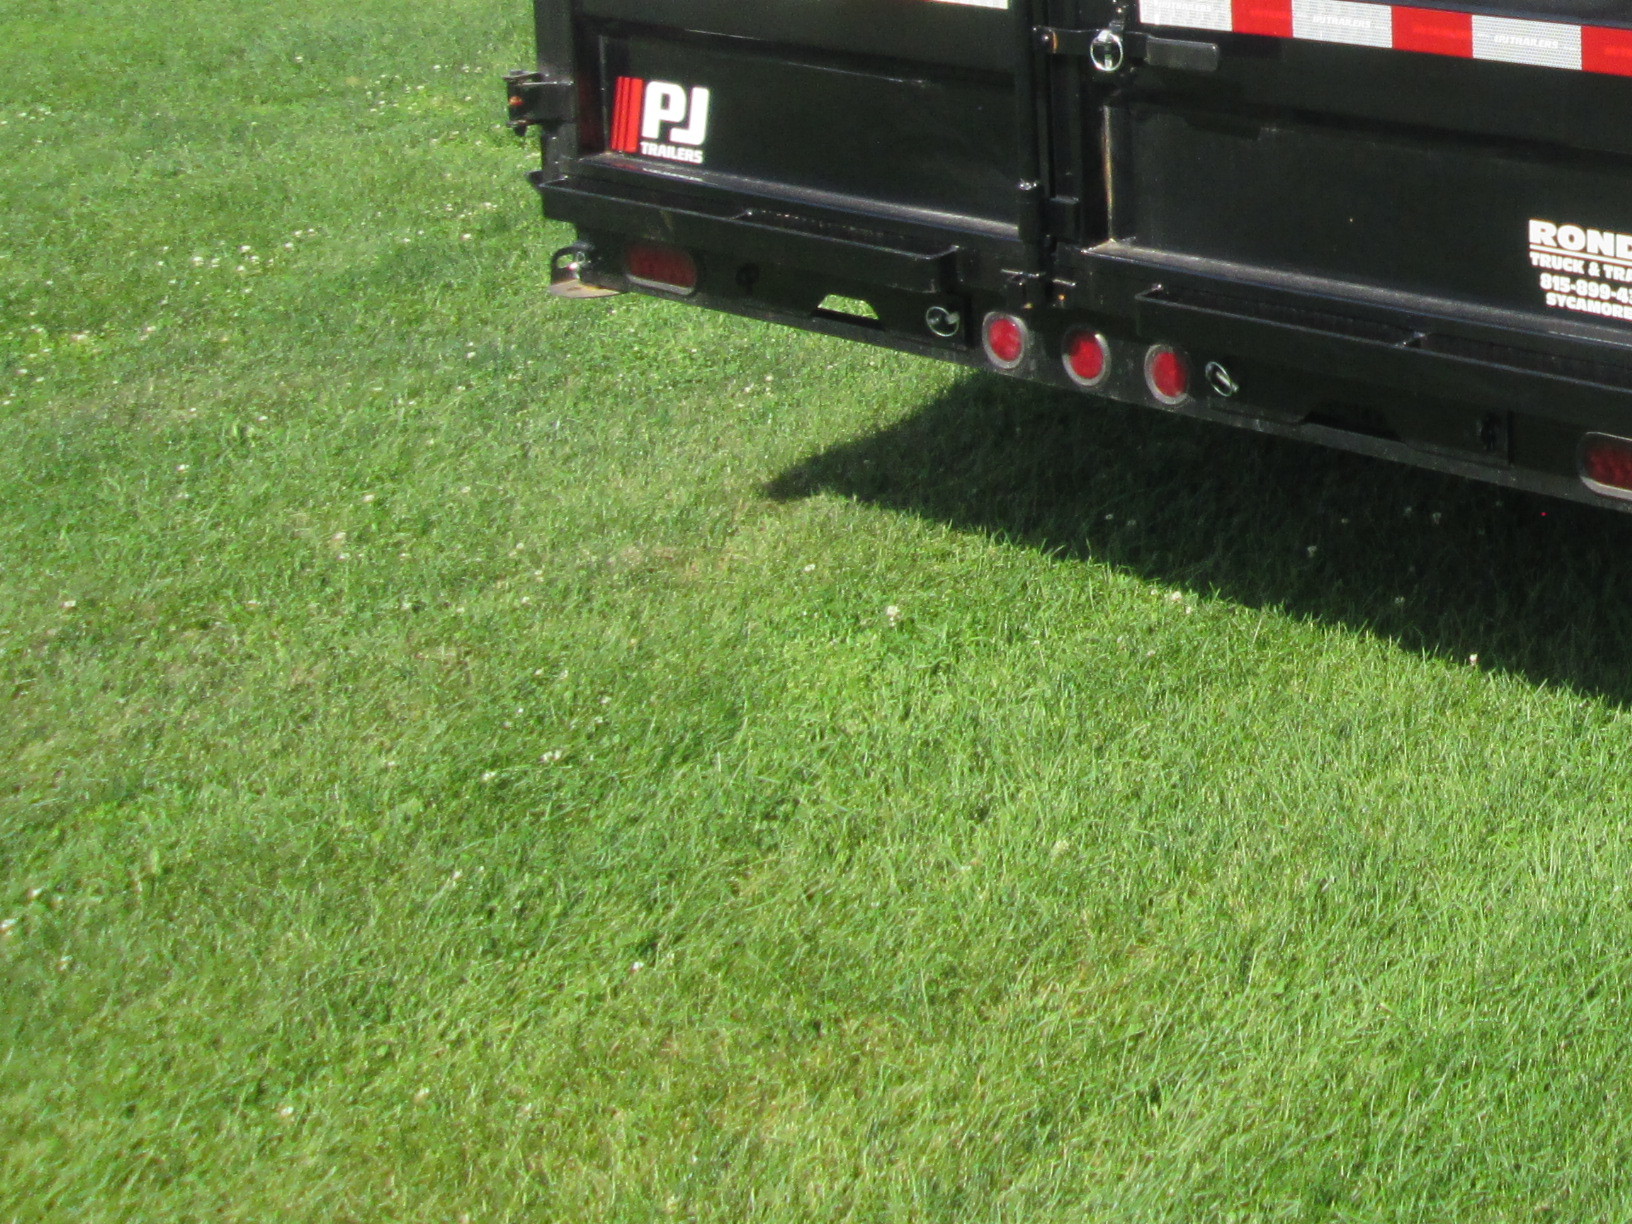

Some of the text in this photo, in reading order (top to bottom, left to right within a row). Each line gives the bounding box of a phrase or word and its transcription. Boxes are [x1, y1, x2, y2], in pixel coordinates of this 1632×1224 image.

[641, 80, 709, 146] PJ
[640, 141, 704, 164] TRAILERS
[1529, 251, 1585, 274] TRUCK
[1588, 261, 1600, 277] &
